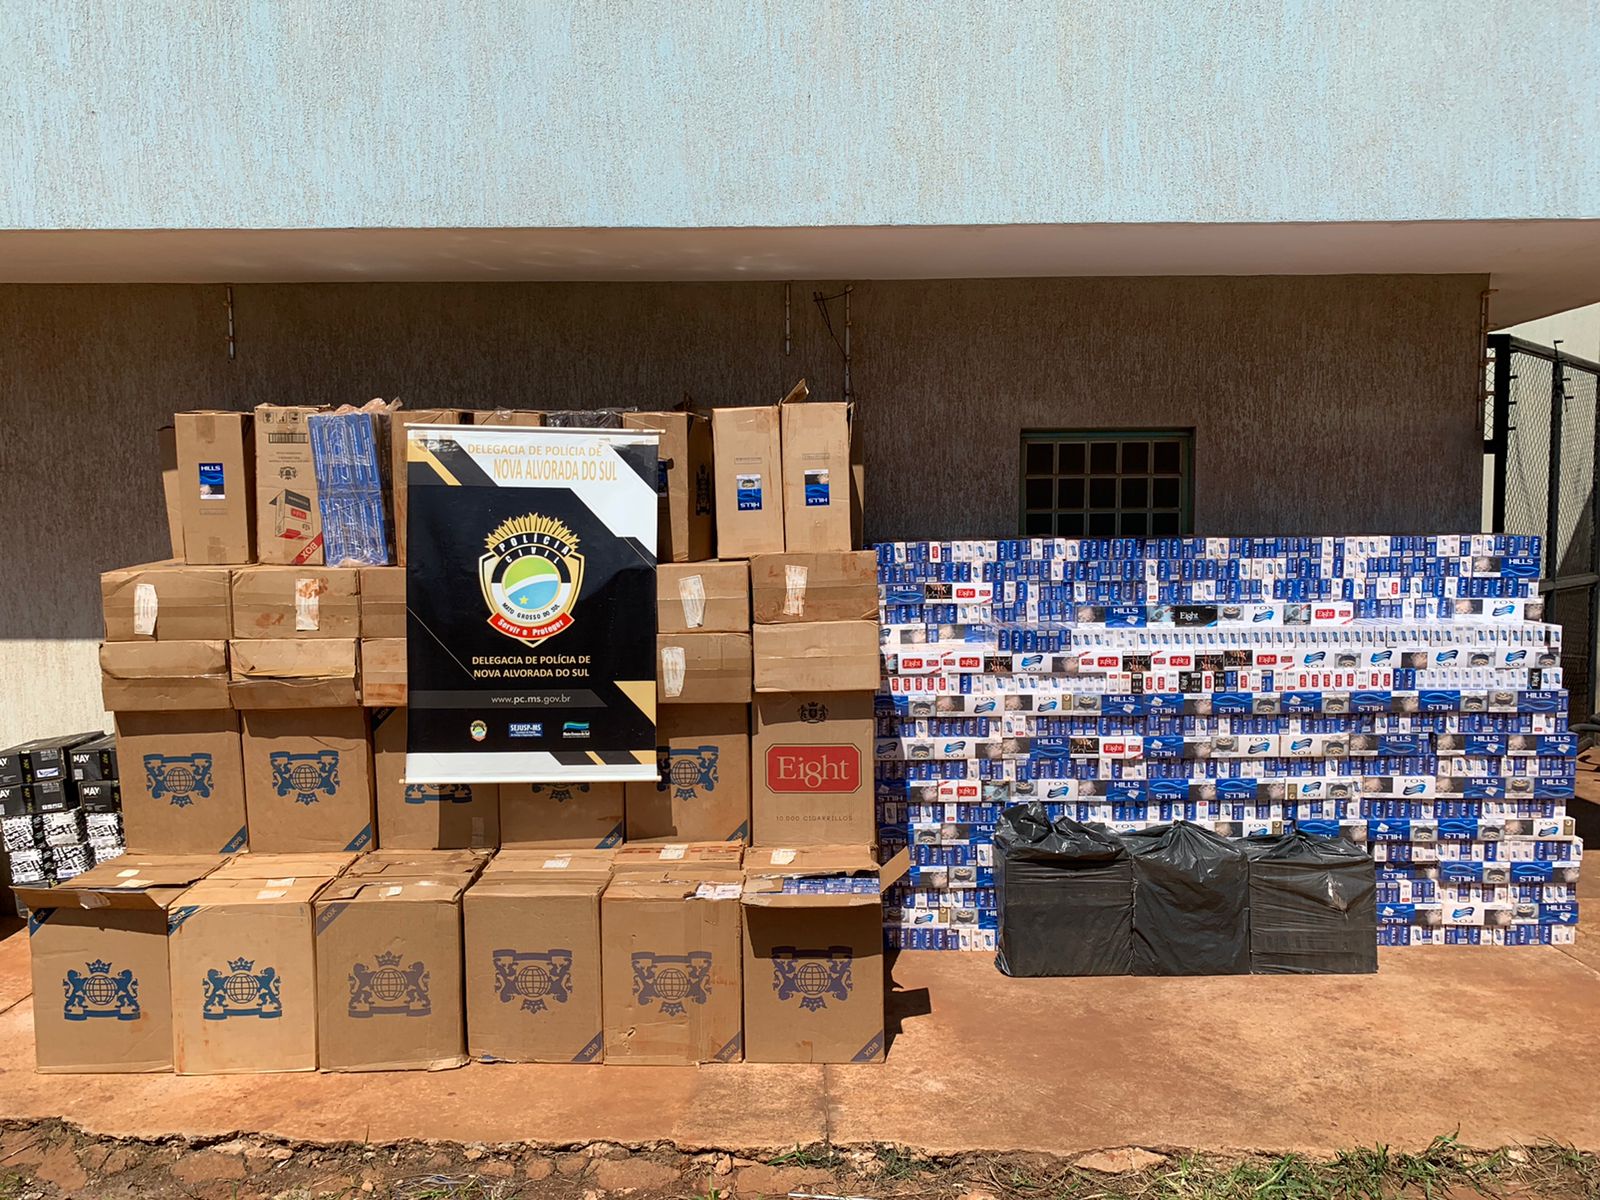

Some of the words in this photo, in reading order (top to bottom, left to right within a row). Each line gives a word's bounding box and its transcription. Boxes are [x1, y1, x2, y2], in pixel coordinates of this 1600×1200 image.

[468, 444, 525, 455] DELEGACIA
[529, 445, 542, 456] DE
[546, 444, 586, 456] POLÍCIA
[588, 446, 602, 456] DE
[494, 458, 522, 480] NOVA
[525, 460, 578, 480] ALVORADA
[582, 460, 597, 480] DO
[600, 460, 617, 480] SUL
[301, 542, 318, 559] BOX
[506, 547, 559, 564] CIVIL
[502, 602, 514, 614] MATO
[551, 604, 560, 612] SUL
[498, 618, 520, 634] Servir
[532, 620, 564, 636] Proteger
[472, 656, 523, 665] DELEGACIA
[526, 656, 538, 664] DE
[540, 654, 576, 664] POLÍCIA
[578, 656, 591, 664] DE
[474, 669, 501, 678] NOVA
[503, 669, 553, 677] ALVORADA
[556, 669, 570, 677] DO
[572, 668, 589, 677] SUL
[492, 694, 571, 704] www.pc.ms.gov.br
[73, 755, 90, 763] NAY
[777, 754, 849, 788] Eight
[84, 787, 100, 796] NAY
[584, 1043, 598, 1057] BOX
[864, 1042, 879, 1057] BOX
